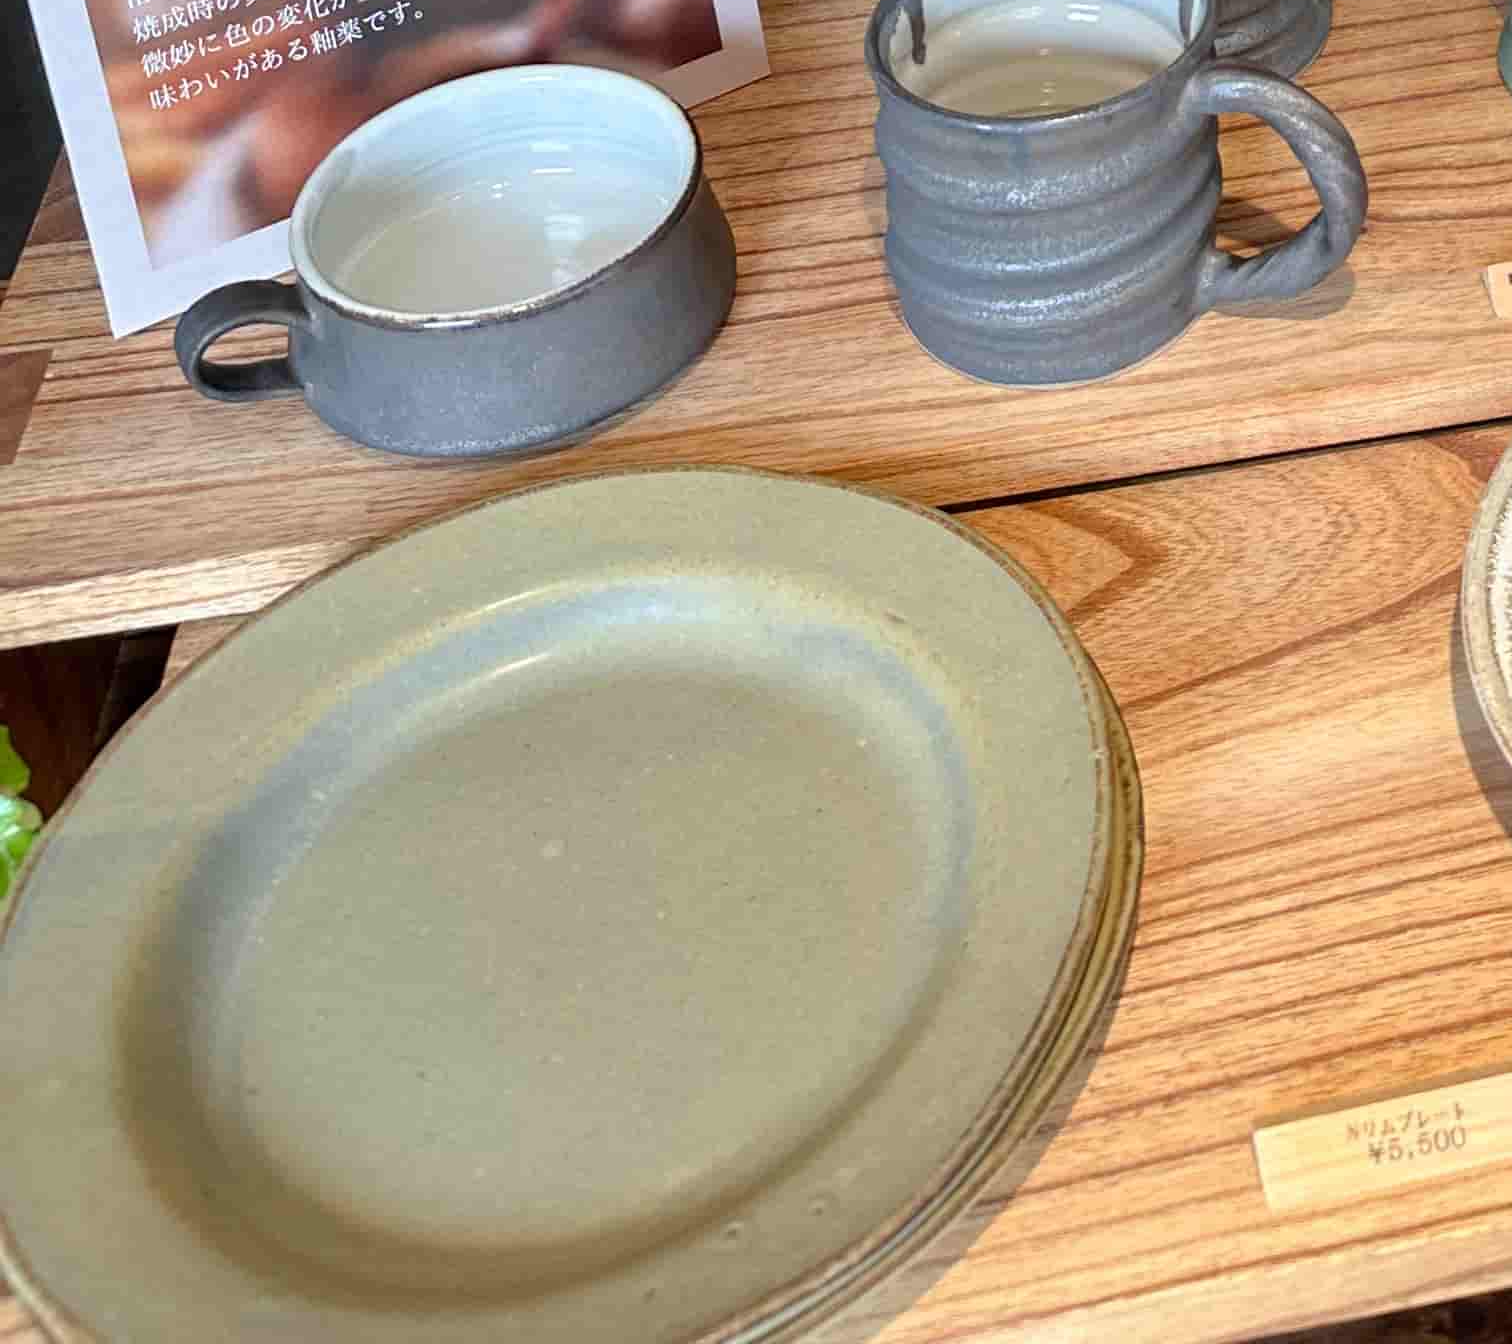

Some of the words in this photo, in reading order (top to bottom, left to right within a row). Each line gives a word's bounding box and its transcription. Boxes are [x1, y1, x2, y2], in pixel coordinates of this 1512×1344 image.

[148, 0, 424, 111] 味わいがある釉薬です。
